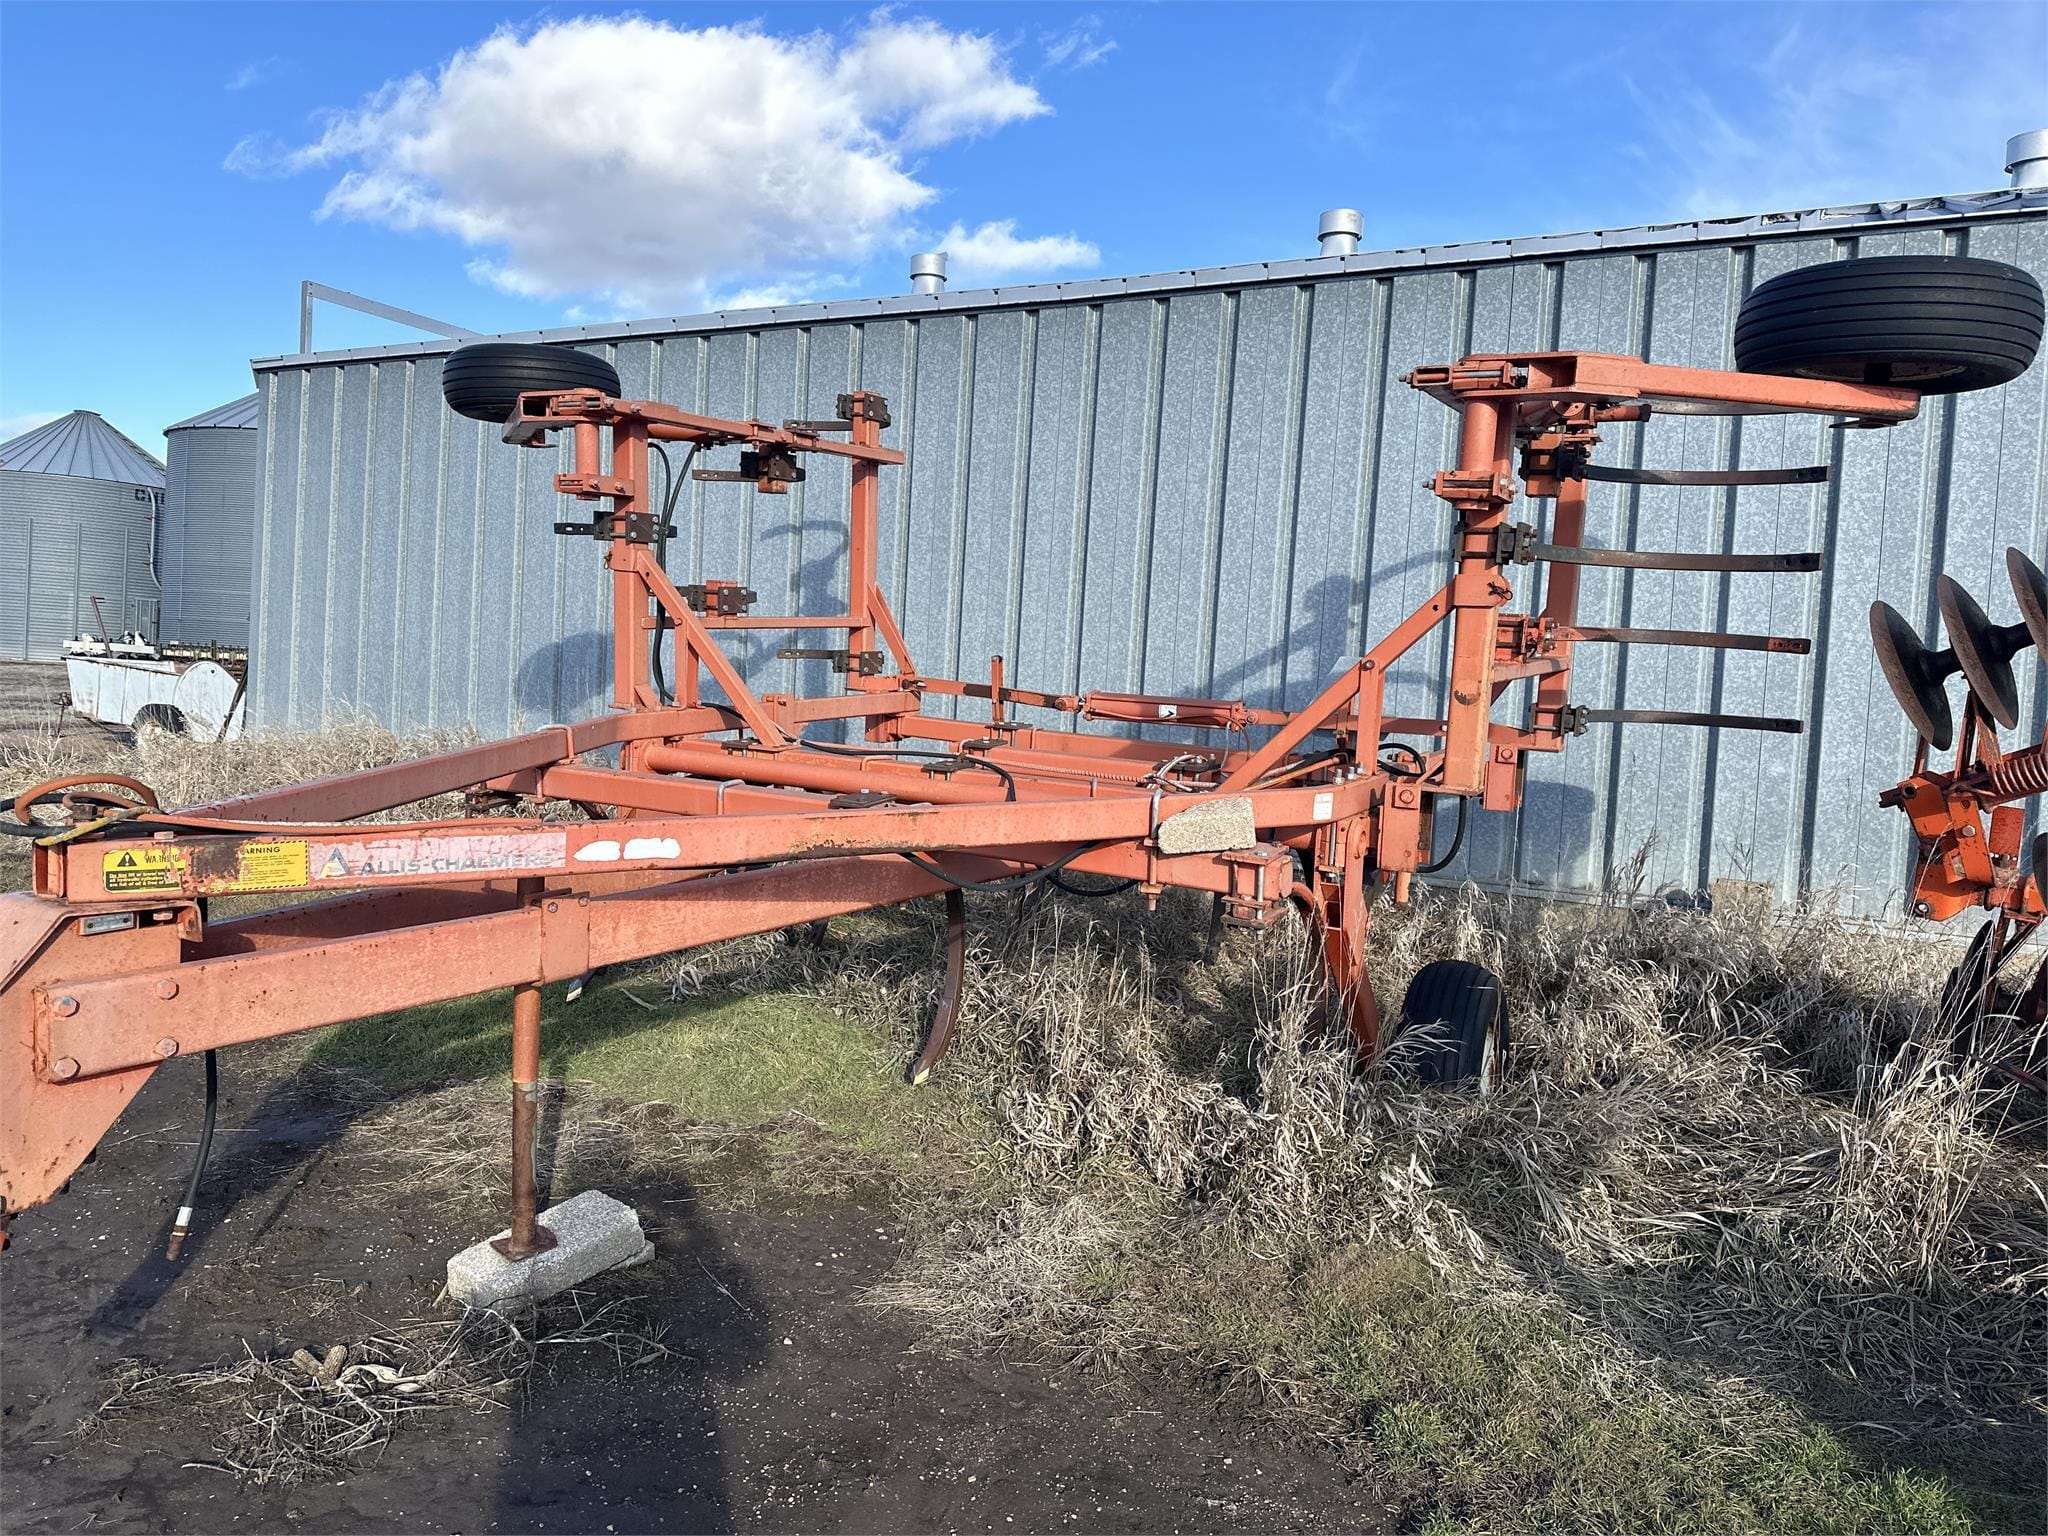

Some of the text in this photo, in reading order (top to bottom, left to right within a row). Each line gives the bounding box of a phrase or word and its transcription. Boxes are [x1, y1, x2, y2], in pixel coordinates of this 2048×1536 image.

[246, 846, 281, 854] ARNING
[144, 854, 179, 863] WARNG
[359, 853, 552, 875] ALLIS-CHALMERS
